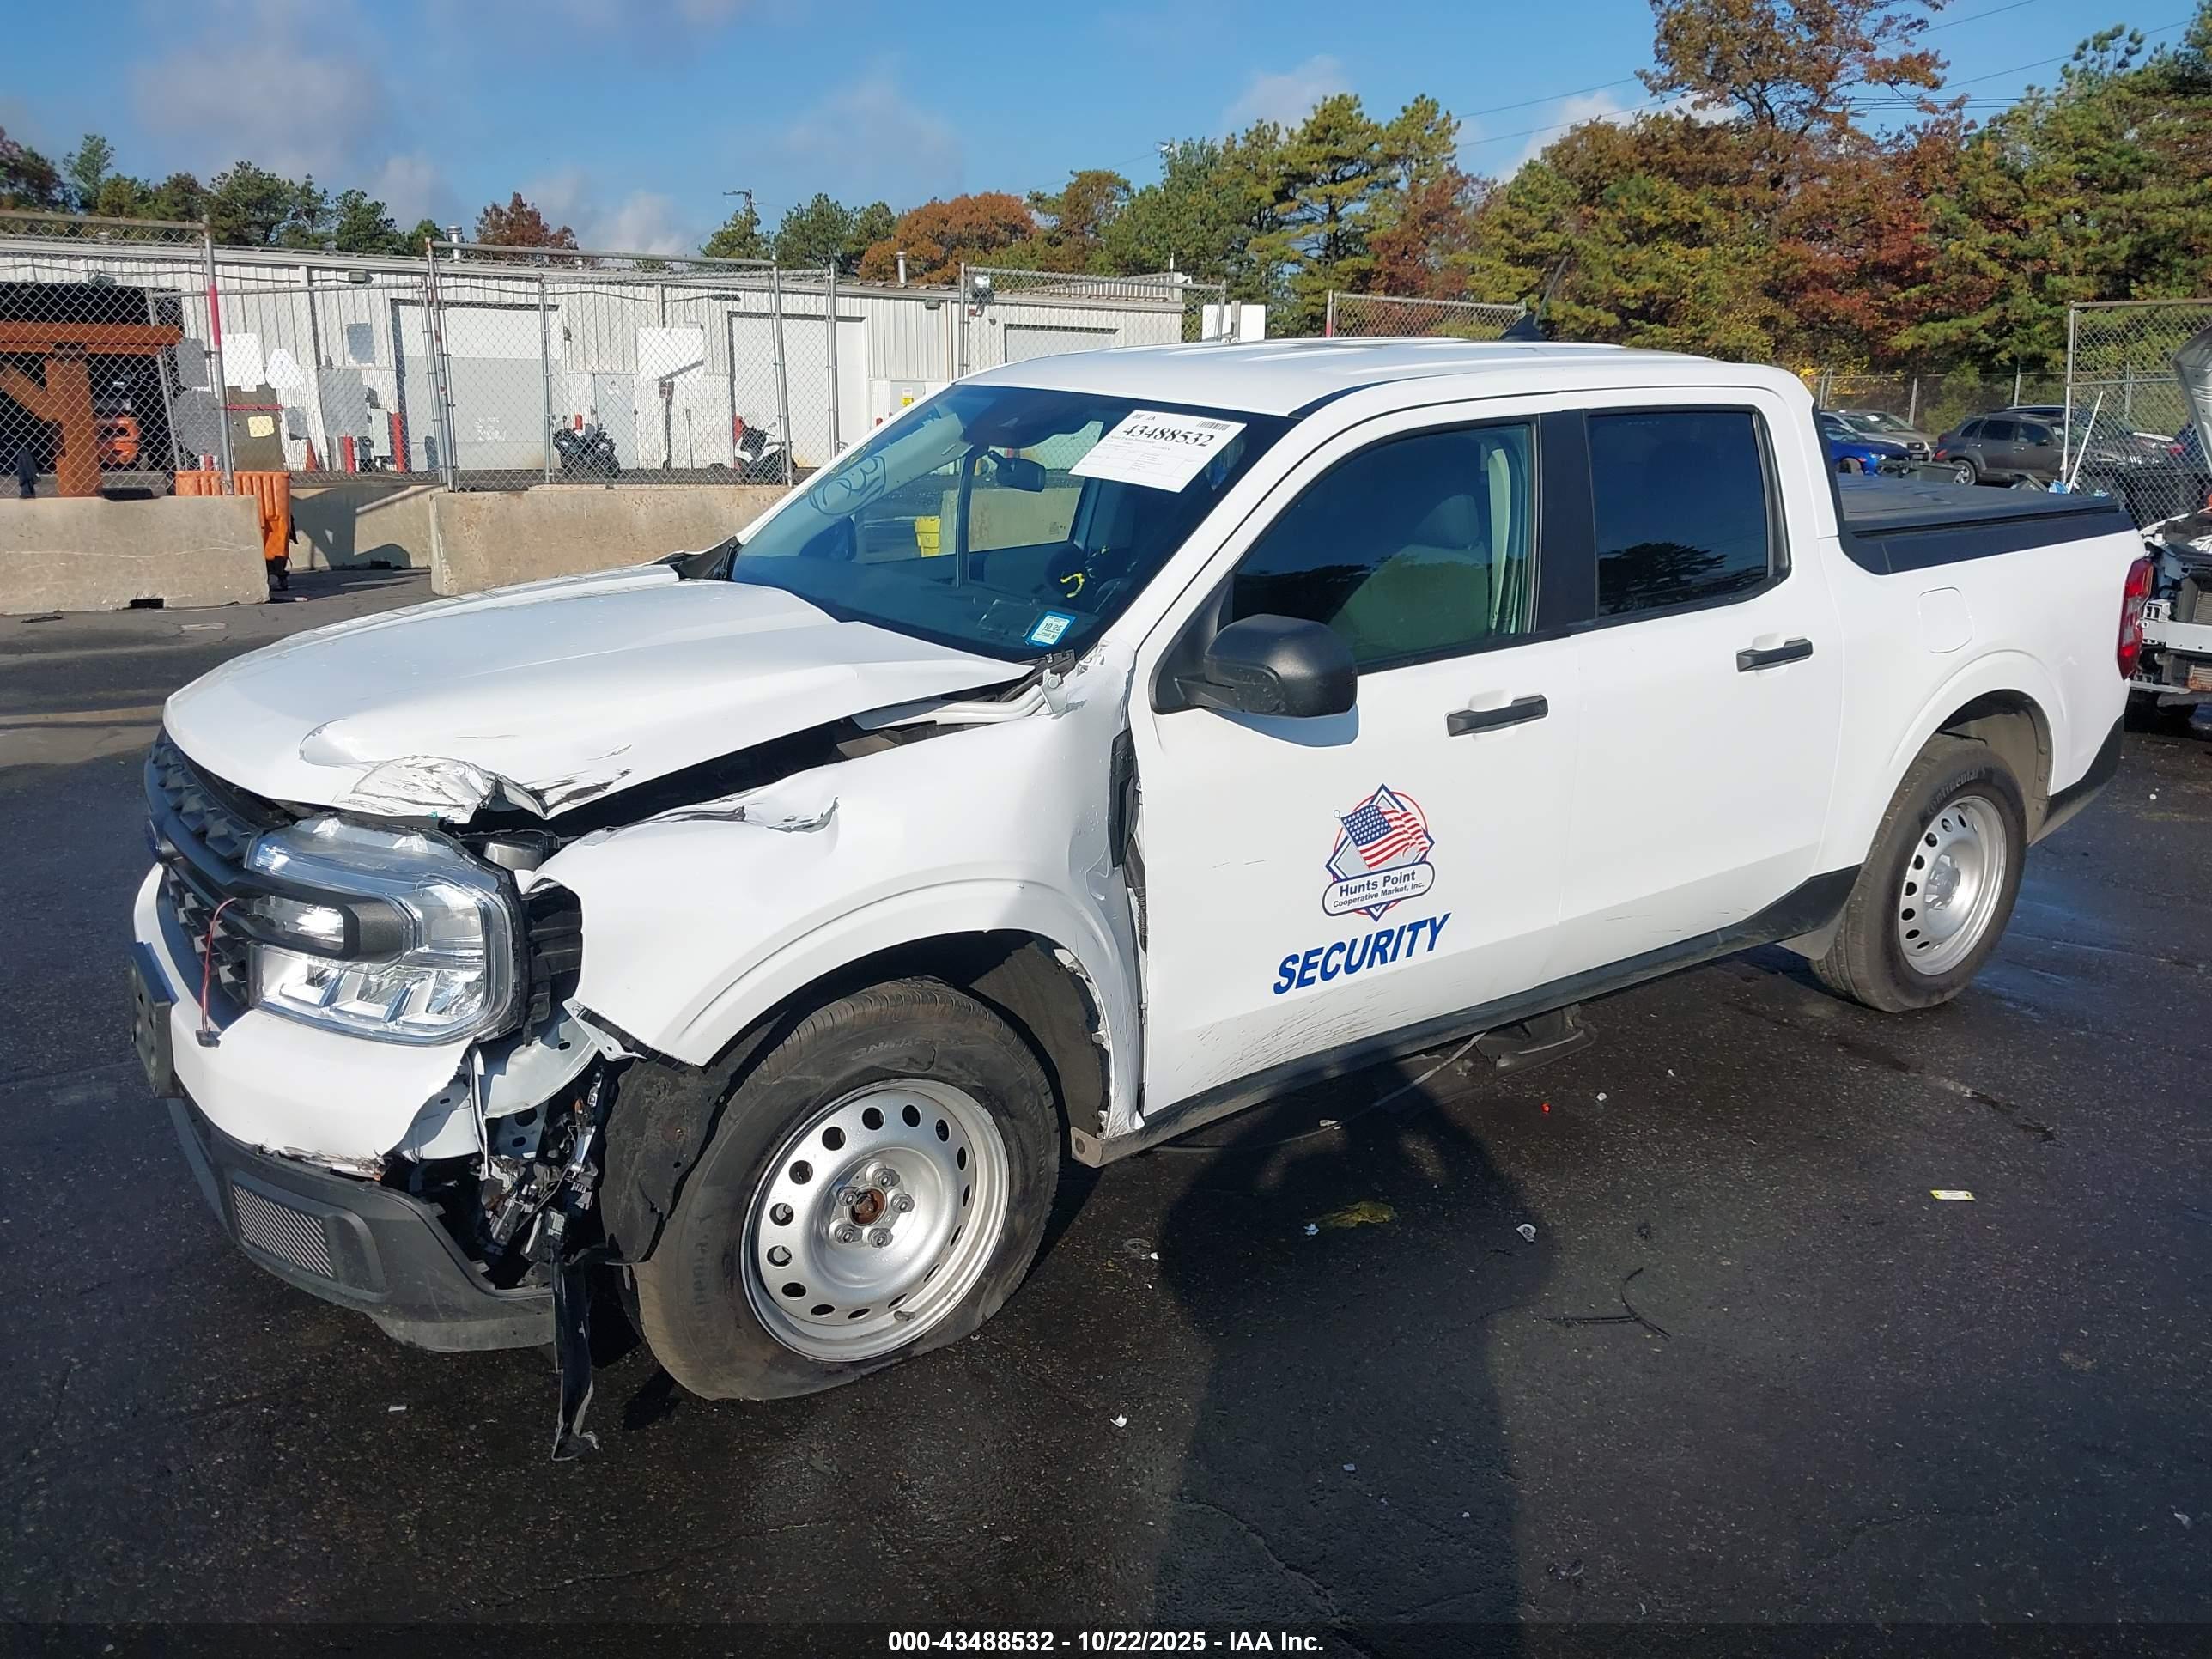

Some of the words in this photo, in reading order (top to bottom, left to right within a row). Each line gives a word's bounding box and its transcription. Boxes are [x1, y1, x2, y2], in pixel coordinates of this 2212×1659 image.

[1123, 424, 1215, 447] 43488532
[1333, 892, 1379, 908] Cooperative
[1381, 886, 1409, 897] Market,
[1411, 882, 1425, 890] Inc.
[1340, 879, 1378, 897] Hunts
[1382, 869, 1416, 887] Point
[1273, 913, 1451, 994] SECURITY
